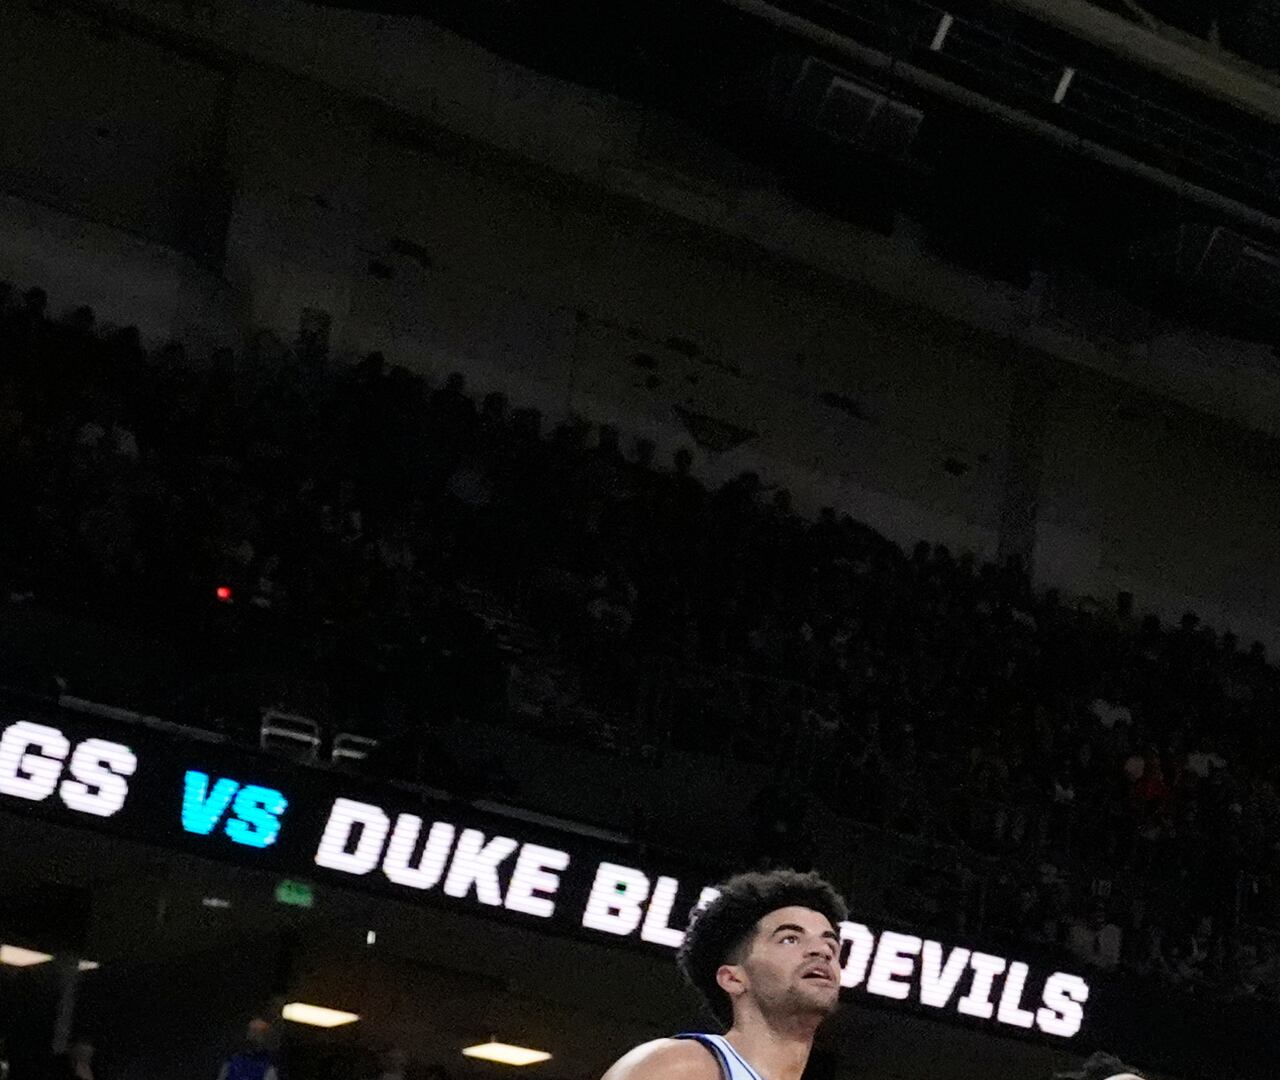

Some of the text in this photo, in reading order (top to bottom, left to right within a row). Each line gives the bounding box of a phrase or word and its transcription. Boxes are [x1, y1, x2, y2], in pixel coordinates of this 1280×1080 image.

[180, 769, 289, 849] VS
[314, 797, 570, 919] DUKE
[582, 861, 722, 948] BL
[837, 920, 1091, 1038] DEVILS
